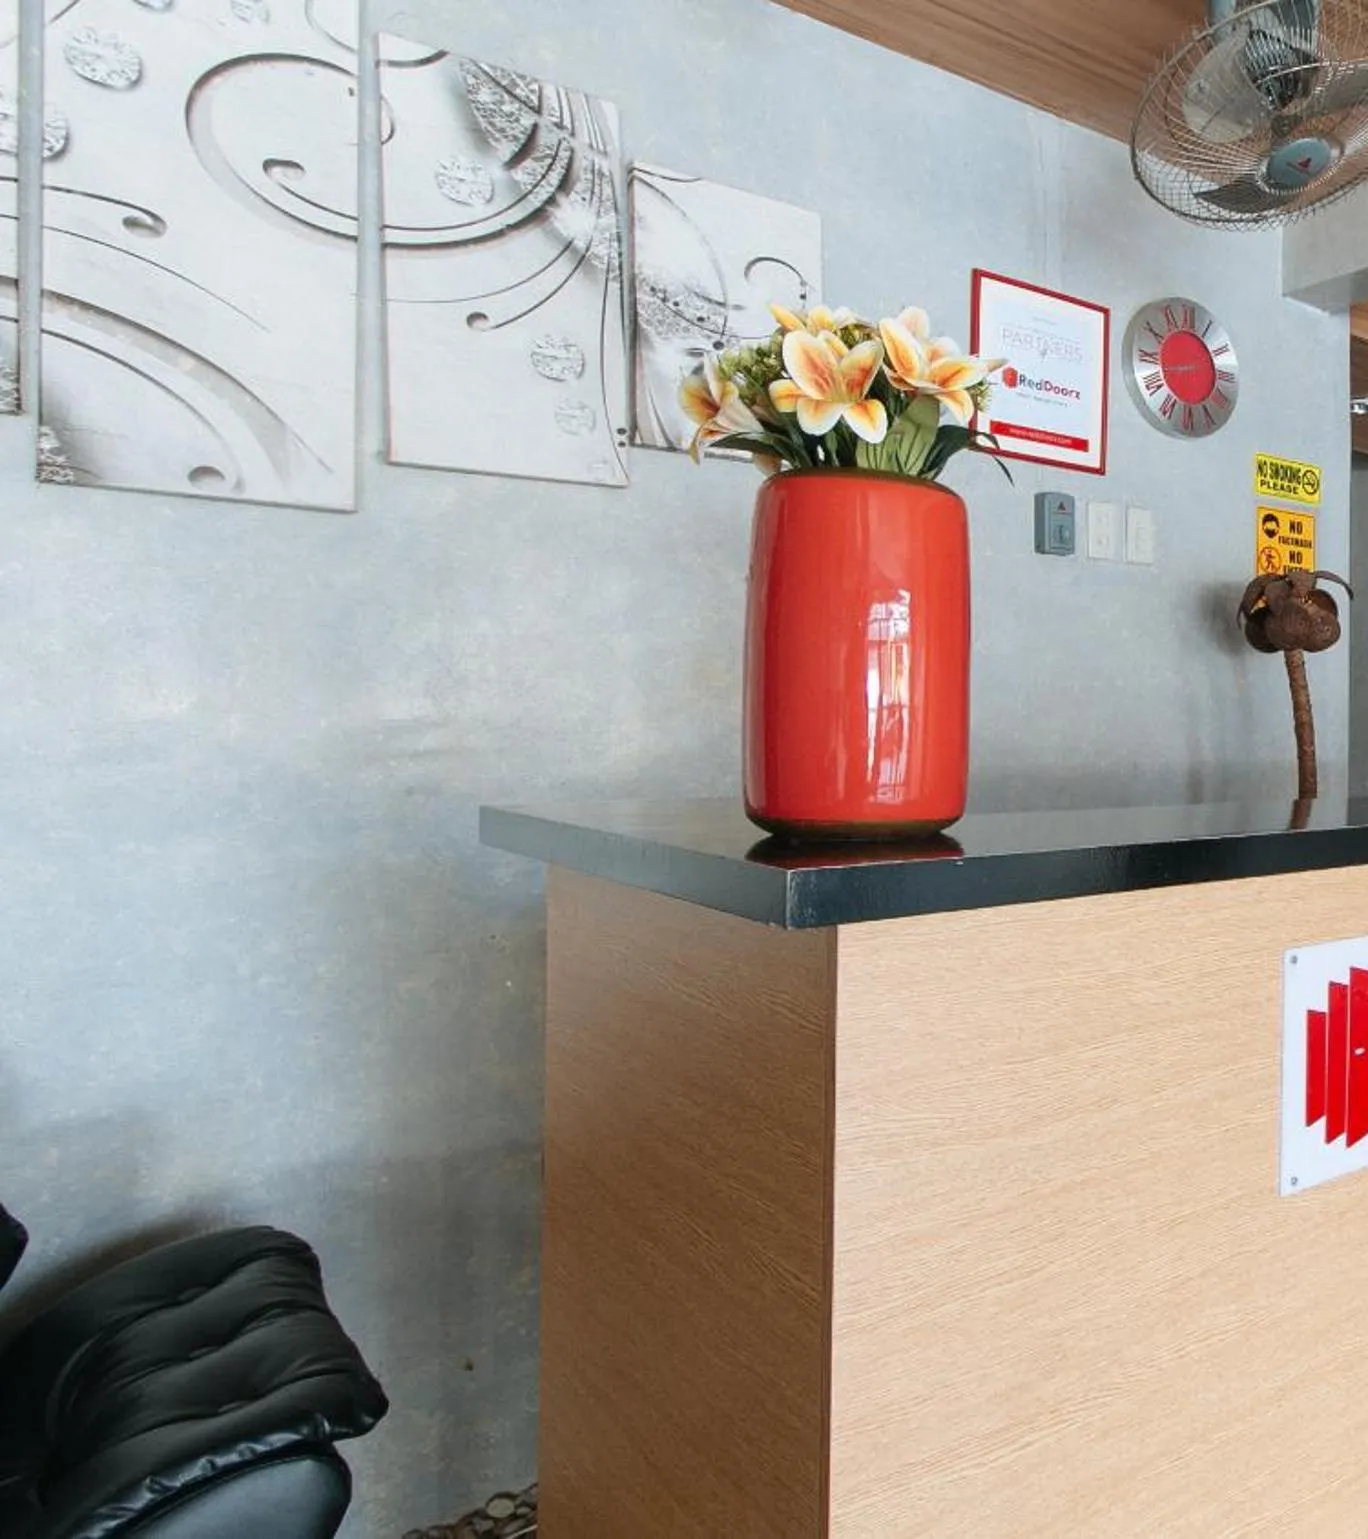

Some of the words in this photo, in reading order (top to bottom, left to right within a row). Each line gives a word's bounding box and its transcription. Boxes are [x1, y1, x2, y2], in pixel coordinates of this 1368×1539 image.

[1257, 460, 1269, 478] NO
[1269, 462, 1301, 486] SMOKING
[1260, 479, 1299, 495] PLEASE
[1289, 520, 1303, 534] NO
[1289, 551, 1303, 564] NO
